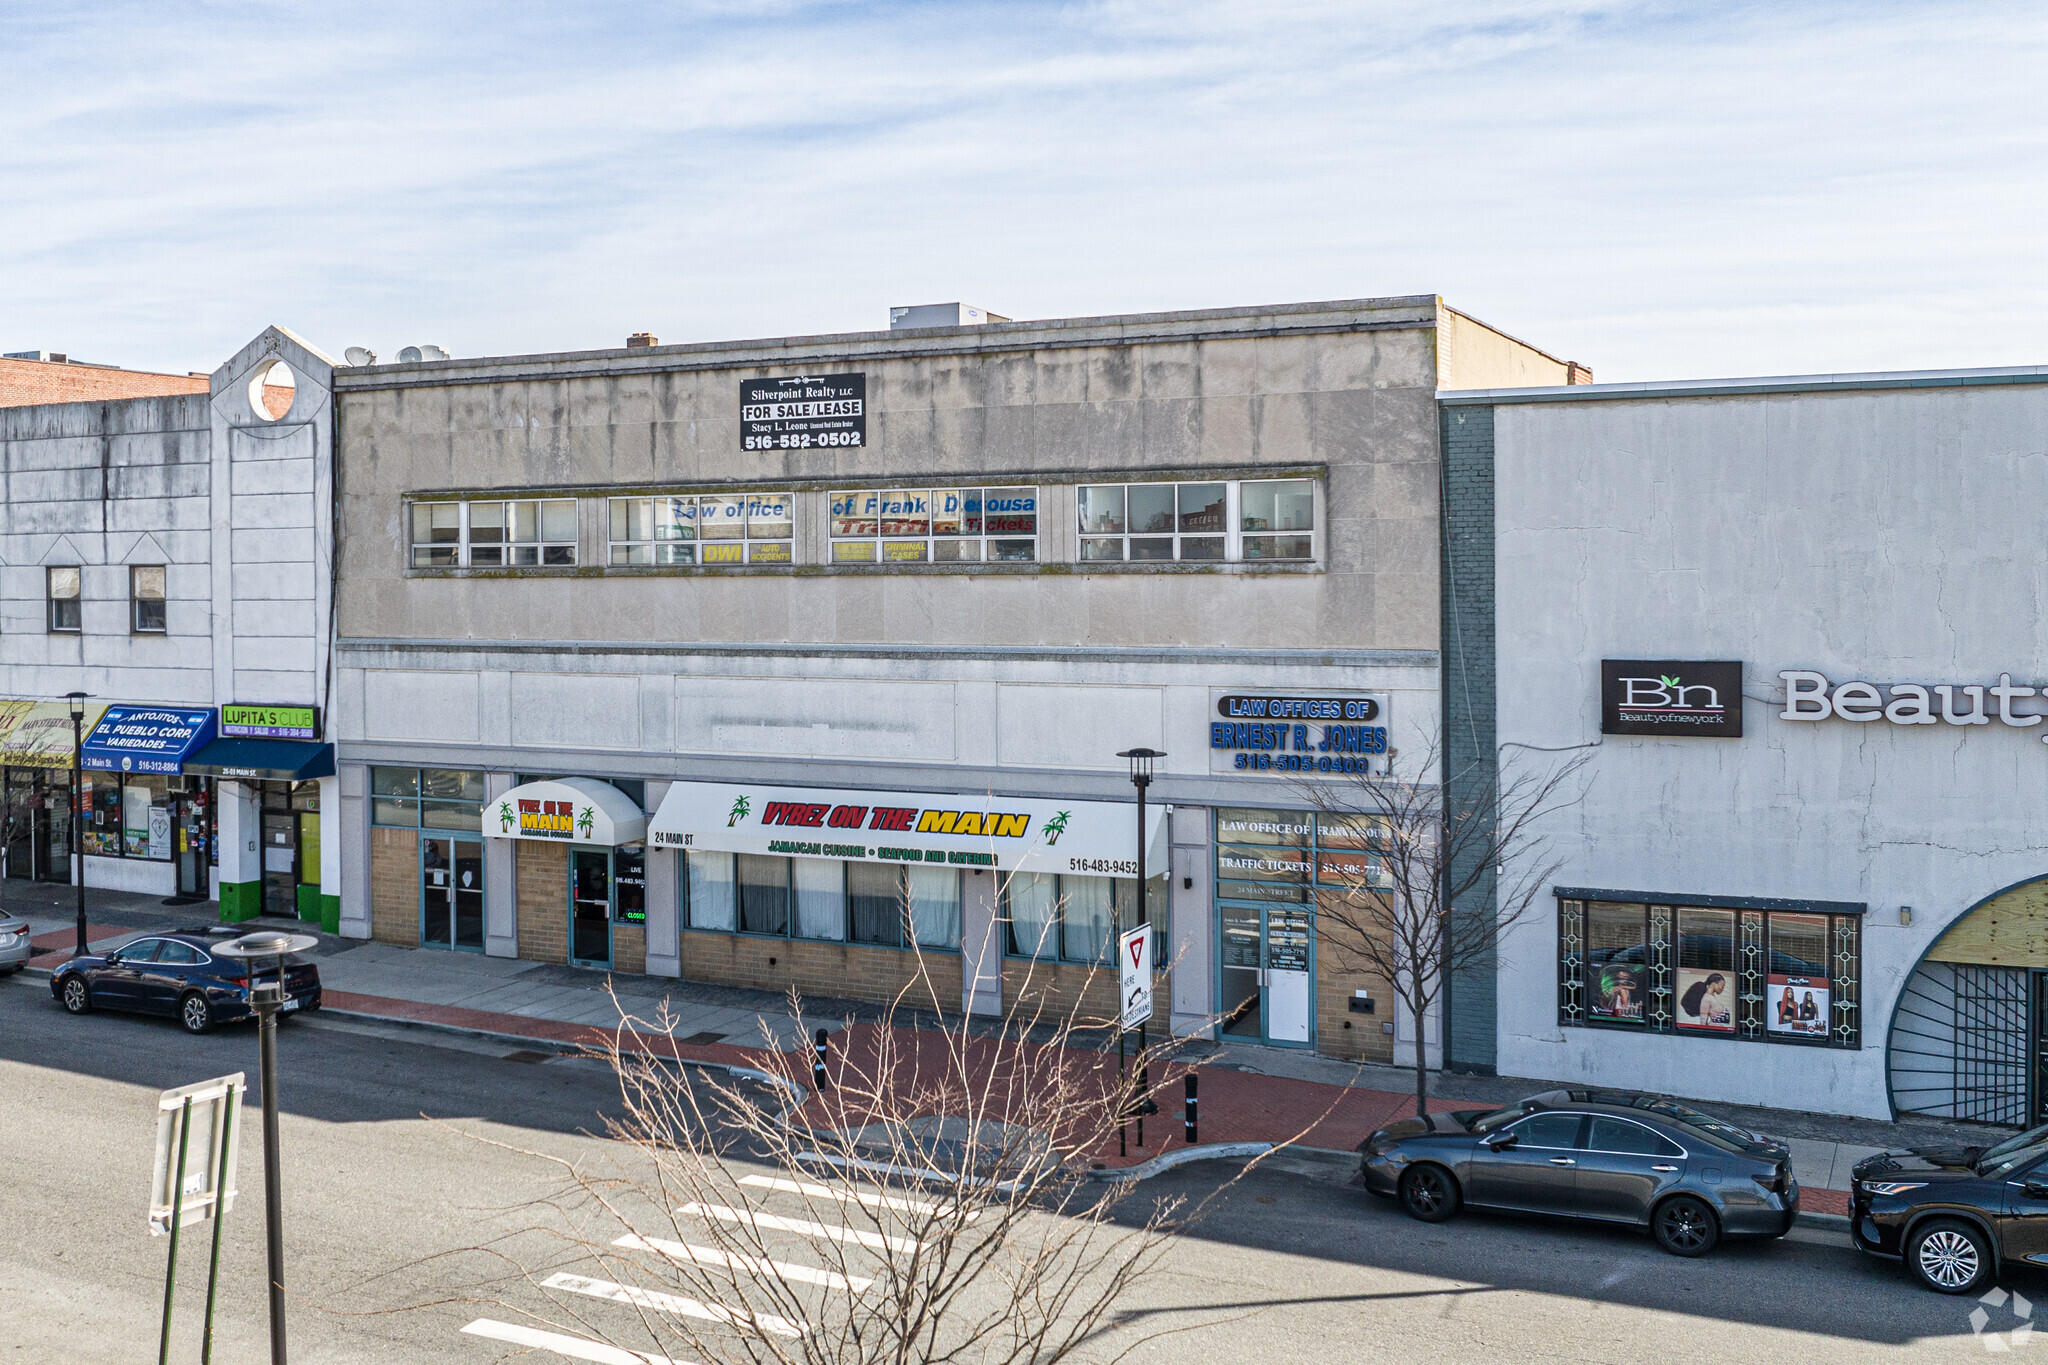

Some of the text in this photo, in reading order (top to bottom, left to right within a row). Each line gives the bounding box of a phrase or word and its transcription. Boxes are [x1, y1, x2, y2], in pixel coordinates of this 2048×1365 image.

[751, 386, 853, 401] Silverpoint Realty LLC
[745, 401, 860, 419] FOR SALE/LEASE
[751, 423, 772, 433] Stacy
[775, 422, 783, 431] L.
[785, 421, 808, 431] Leone
[745, 431, 860, 449] 516-582-0502
[676, 503, 717, 518] Law
[725, 501, 784, 517] office
[832, 498, 854, 515] of
[864, 497, 927, 514] Frank
[966, 516, 1034, 531] Tickets
[703, 545, 742, 562] DWI
[760, 544, 780, 552] AUTO
[884, 542, 927, 550] CRIMINAL
[751, 553, 790, 561] ACCIDENTS
[890, 551, 919, 559] CASES
[1618, 677, 1724, 708] Bn
[1229, 699, 1369, 719] LAW OFFICES OF
[1778, 670, 2048, 744] Beaut
[127, 711, 181, 725] ANTOJITOS
[225, 709, 312, 727] LUPITA'S CLUB
[1620, 712, 1724, 724] Beautyofnewyork
[96, 724, 111, 734] EL
[112, 725, 157, 737] PUEBLO
[158, 727, 193, 739] CORP.
[254, 726, 269, 736] SALUD
[1211, 721, 1388, 754] ERNEST R. JONES
[106, 737, 167, 749] VARIEDADES
[92, 758, 105, 767] Main
[1234, 753, 1368, 774] 516-505-0400
[520, 812, 573, 831] MAIN
[761, 801, 1031, 838] VYBEZ ON THE MAIN
[1221, 821, 1248, 832] LAW
[1250, 822, 1292, 834] OFFICE
[1294, 825, 1310, 835] OF
[1317, 825, 1349, 836] FRANK
[655, 831, 694, 845] 24 MAIN ST
[768, 840, 999, 866] JAMAICAN CUISINE SEAFOOD AND CATERING
[1070, 858, 1138, 874] 516-483-9452
[1219, 858, 1265, 869] TRAFFIC
[1267, 861, 1312, 873] TICKETS
[1246, 886, 1266, 895] MAIN
[1124, 975, 1135, 988] HERE
